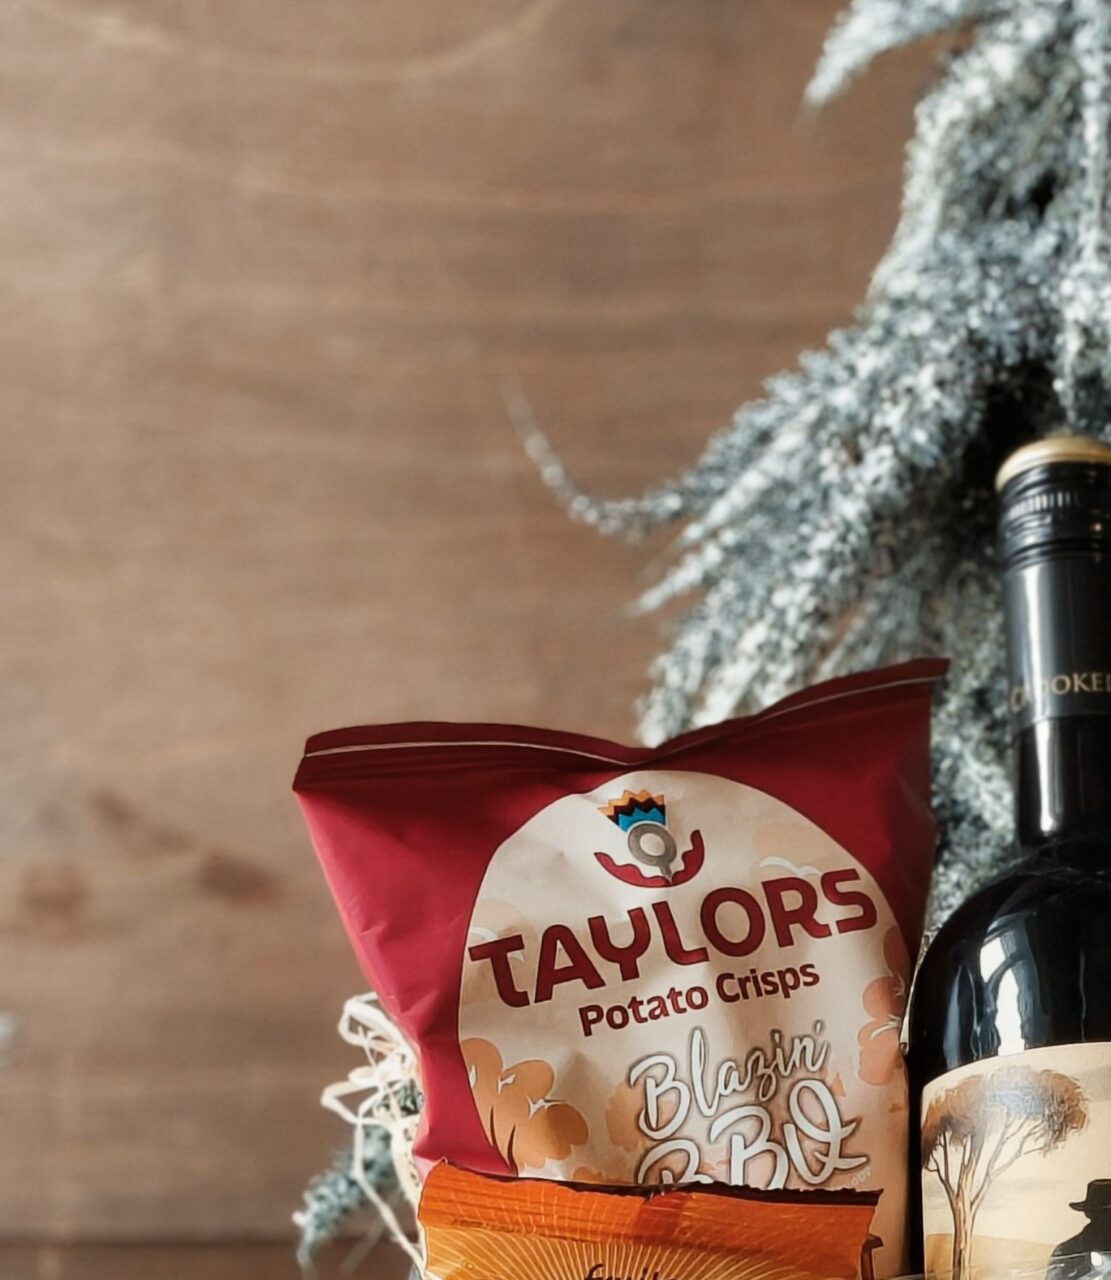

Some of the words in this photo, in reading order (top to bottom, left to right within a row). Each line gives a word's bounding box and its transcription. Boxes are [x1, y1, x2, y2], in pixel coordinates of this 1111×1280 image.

[468, 868, 878, 1008] TAYLORS
[578, 984, 709, 1037] Potato
[716, 963, 820, 1004] Crisps
